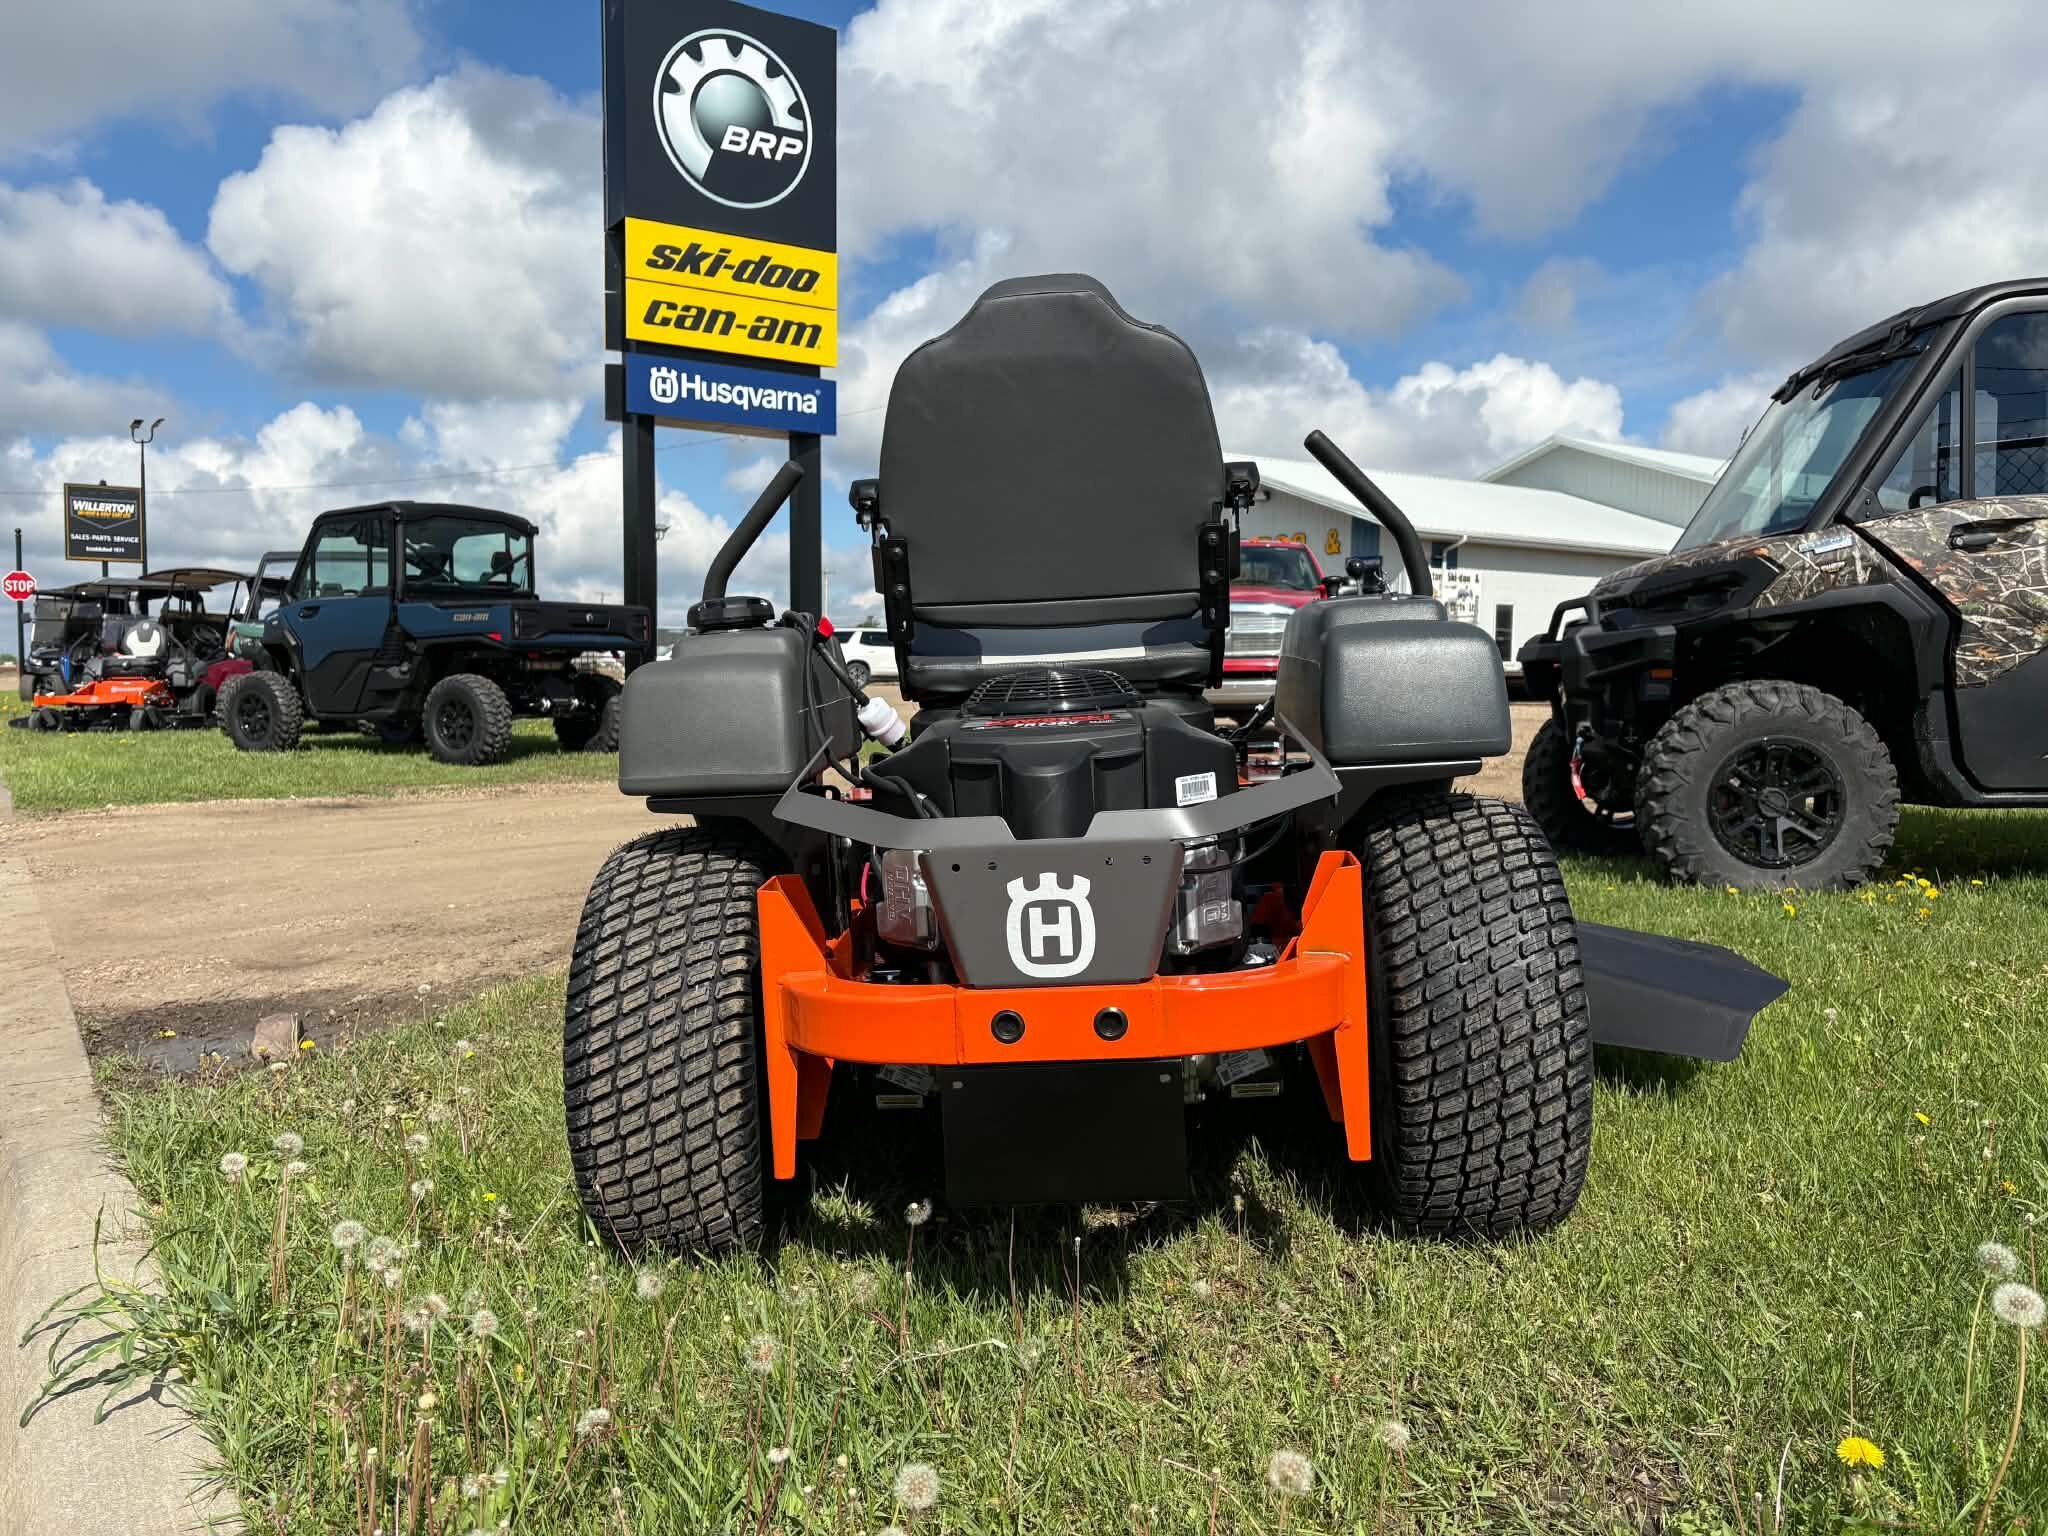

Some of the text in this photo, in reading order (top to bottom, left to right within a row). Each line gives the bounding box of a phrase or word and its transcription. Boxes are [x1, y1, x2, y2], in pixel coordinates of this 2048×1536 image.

[720, 125, 804, 161] BRP
[646, 242, 820, 292] ski-doo
[643, 299, 822, 348] can-am
[681, 372, 818, 414] Husqvarna
[73, 500, 135, 514] WILLERTON
[5, 579, 34, 592] STOP
